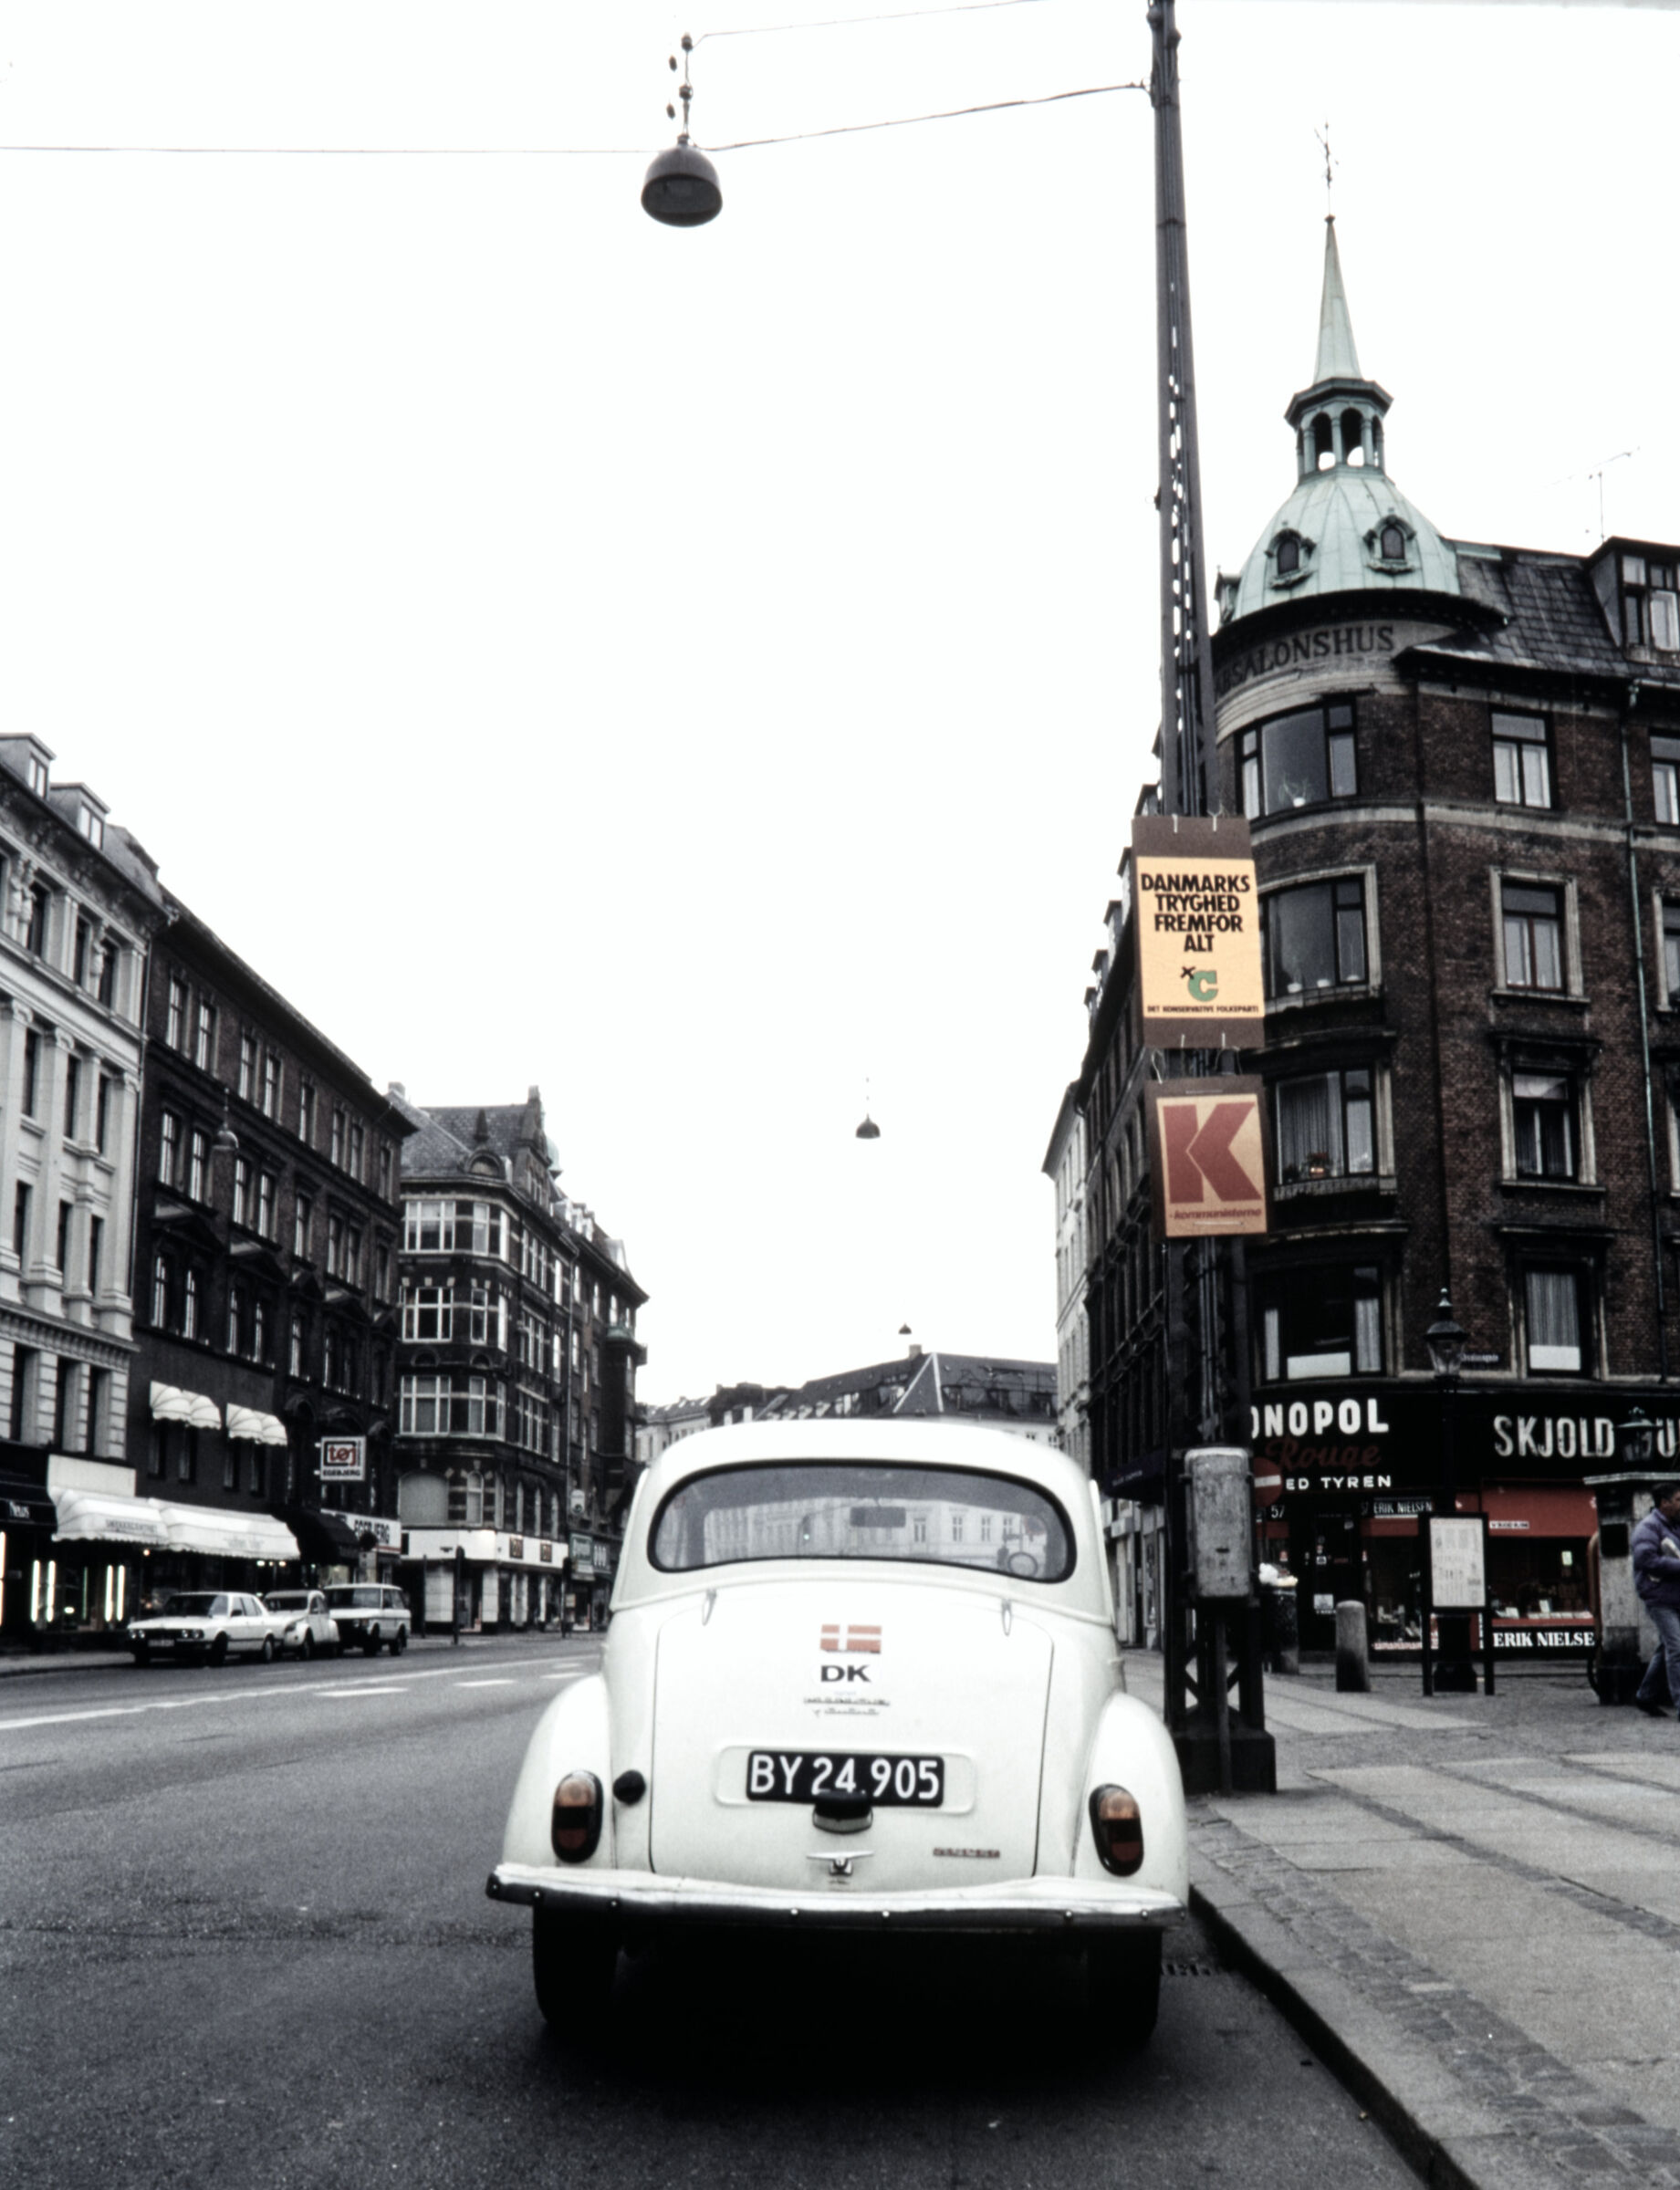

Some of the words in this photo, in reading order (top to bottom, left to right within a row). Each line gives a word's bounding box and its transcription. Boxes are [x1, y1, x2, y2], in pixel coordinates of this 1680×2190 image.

[1141, 873, 1250, 892] DANMARKS
[1154, 893, 1240, 912] TRYGHED
[1154, 914, 1243, 933] FREMFOR
[1184, 934, 1215, 952] ALT
[1163, 1102, 1262, 1204] K
[1494, 1415, 1615, 1457] SKJOLD
[1321, 1476, 1392, 1489] TYREN
[1271, 1506, 1284, 1518] 57
[1373, 1502, 1393, 1514] ERIK
[1397, 1501, 1432, 1513] NIELSEN
[1493, 1632, 1533, 1647] ERIK
[820, 1664, 871, 1683] DK
[750, 1754, 802, 1795] BY
